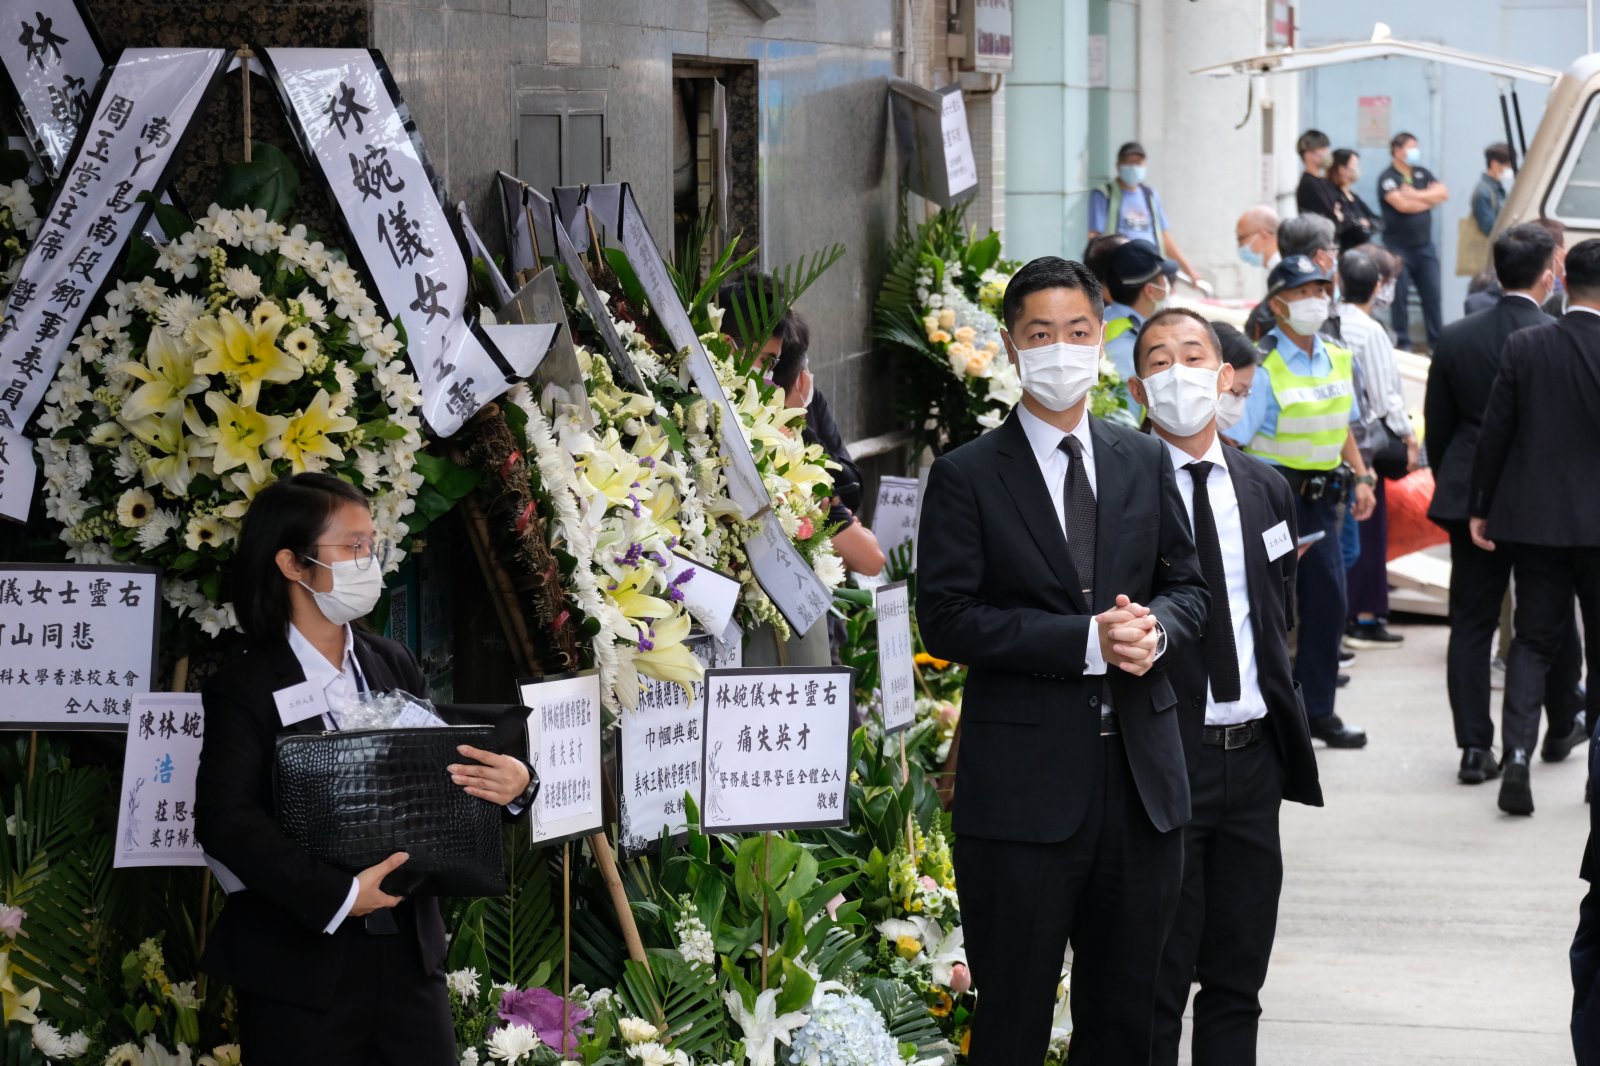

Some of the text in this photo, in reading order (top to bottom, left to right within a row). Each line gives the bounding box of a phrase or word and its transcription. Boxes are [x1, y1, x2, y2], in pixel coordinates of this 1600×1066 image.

[0, 577, 142, 607] 儀女士靈右
[716, 680, 838, 710] 林婉儀女士靈右
[138, 709, 202, 741] 陳林婉
[645, 719, 700, 752] 巾幗典範
[737, 722, 811, 754] 痛失英才
[152, 752, 175, 785] 浩
[719, 767, 841, 790] 警務處邊界警區全體仝人
[154, 798, 197, 823] 莊思
[816, 791, 839, 810] 敬輓
